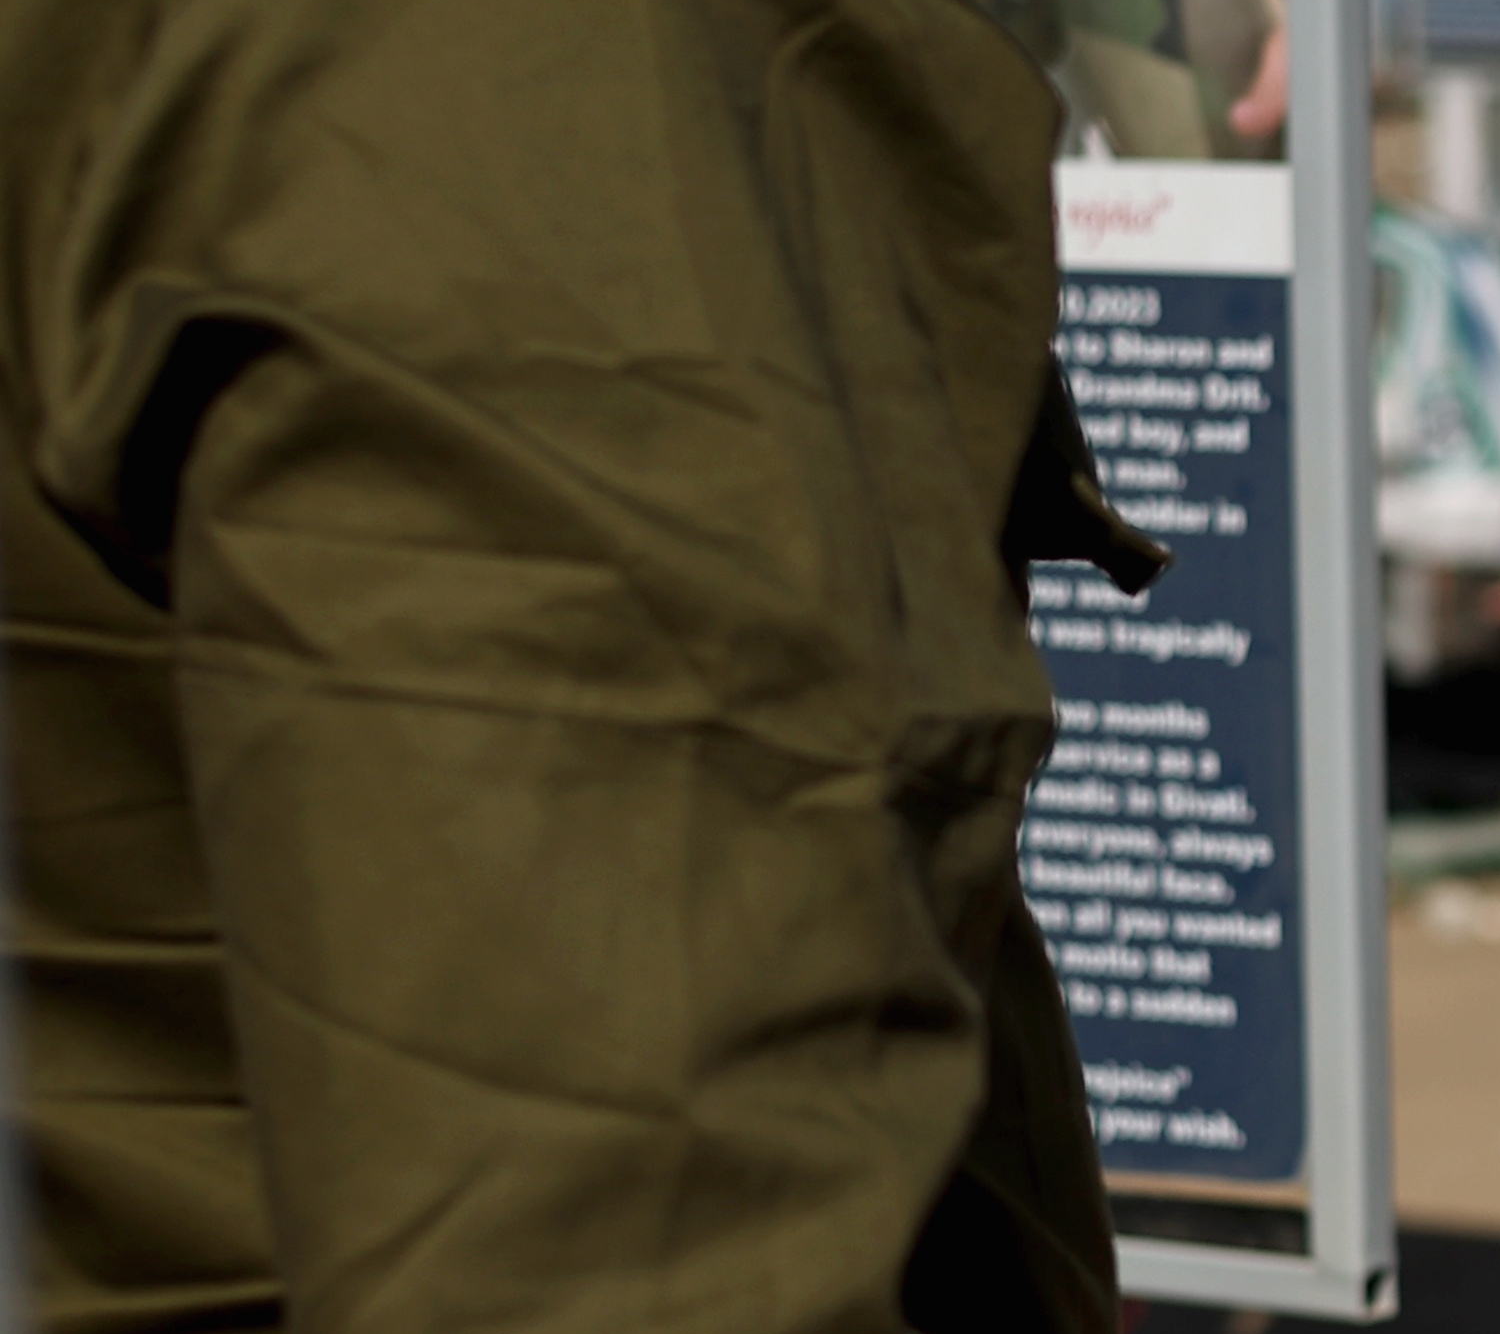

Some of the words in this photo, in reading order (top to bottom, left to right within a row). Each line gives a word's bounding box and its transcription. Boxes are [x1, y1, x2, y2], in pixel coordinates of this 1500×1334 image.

[1215, 334, 1273, 370] and
[1192, 417, 1248, 452] and
[1109, 618, 1252, 668] tragically
